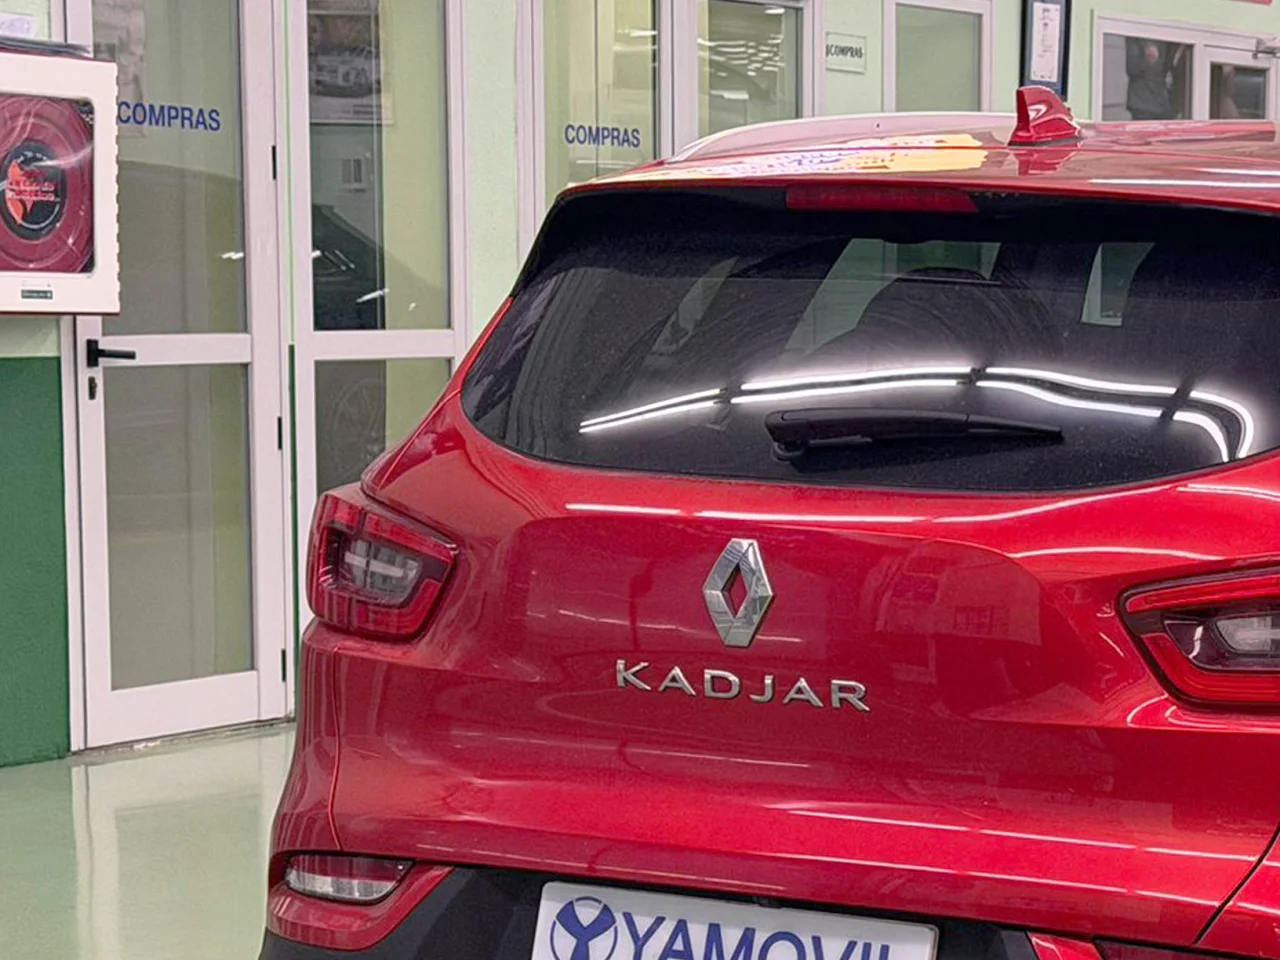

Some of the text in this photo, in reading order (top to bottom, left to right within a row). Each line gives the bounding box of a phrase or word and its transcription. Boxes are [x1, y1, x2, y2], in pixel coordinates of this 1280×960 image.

[118, 101, 220, 132] COMPRAS
[565, 124, 641, 148] COMPRAS
[616, 659, 870, 711] KADJAR
